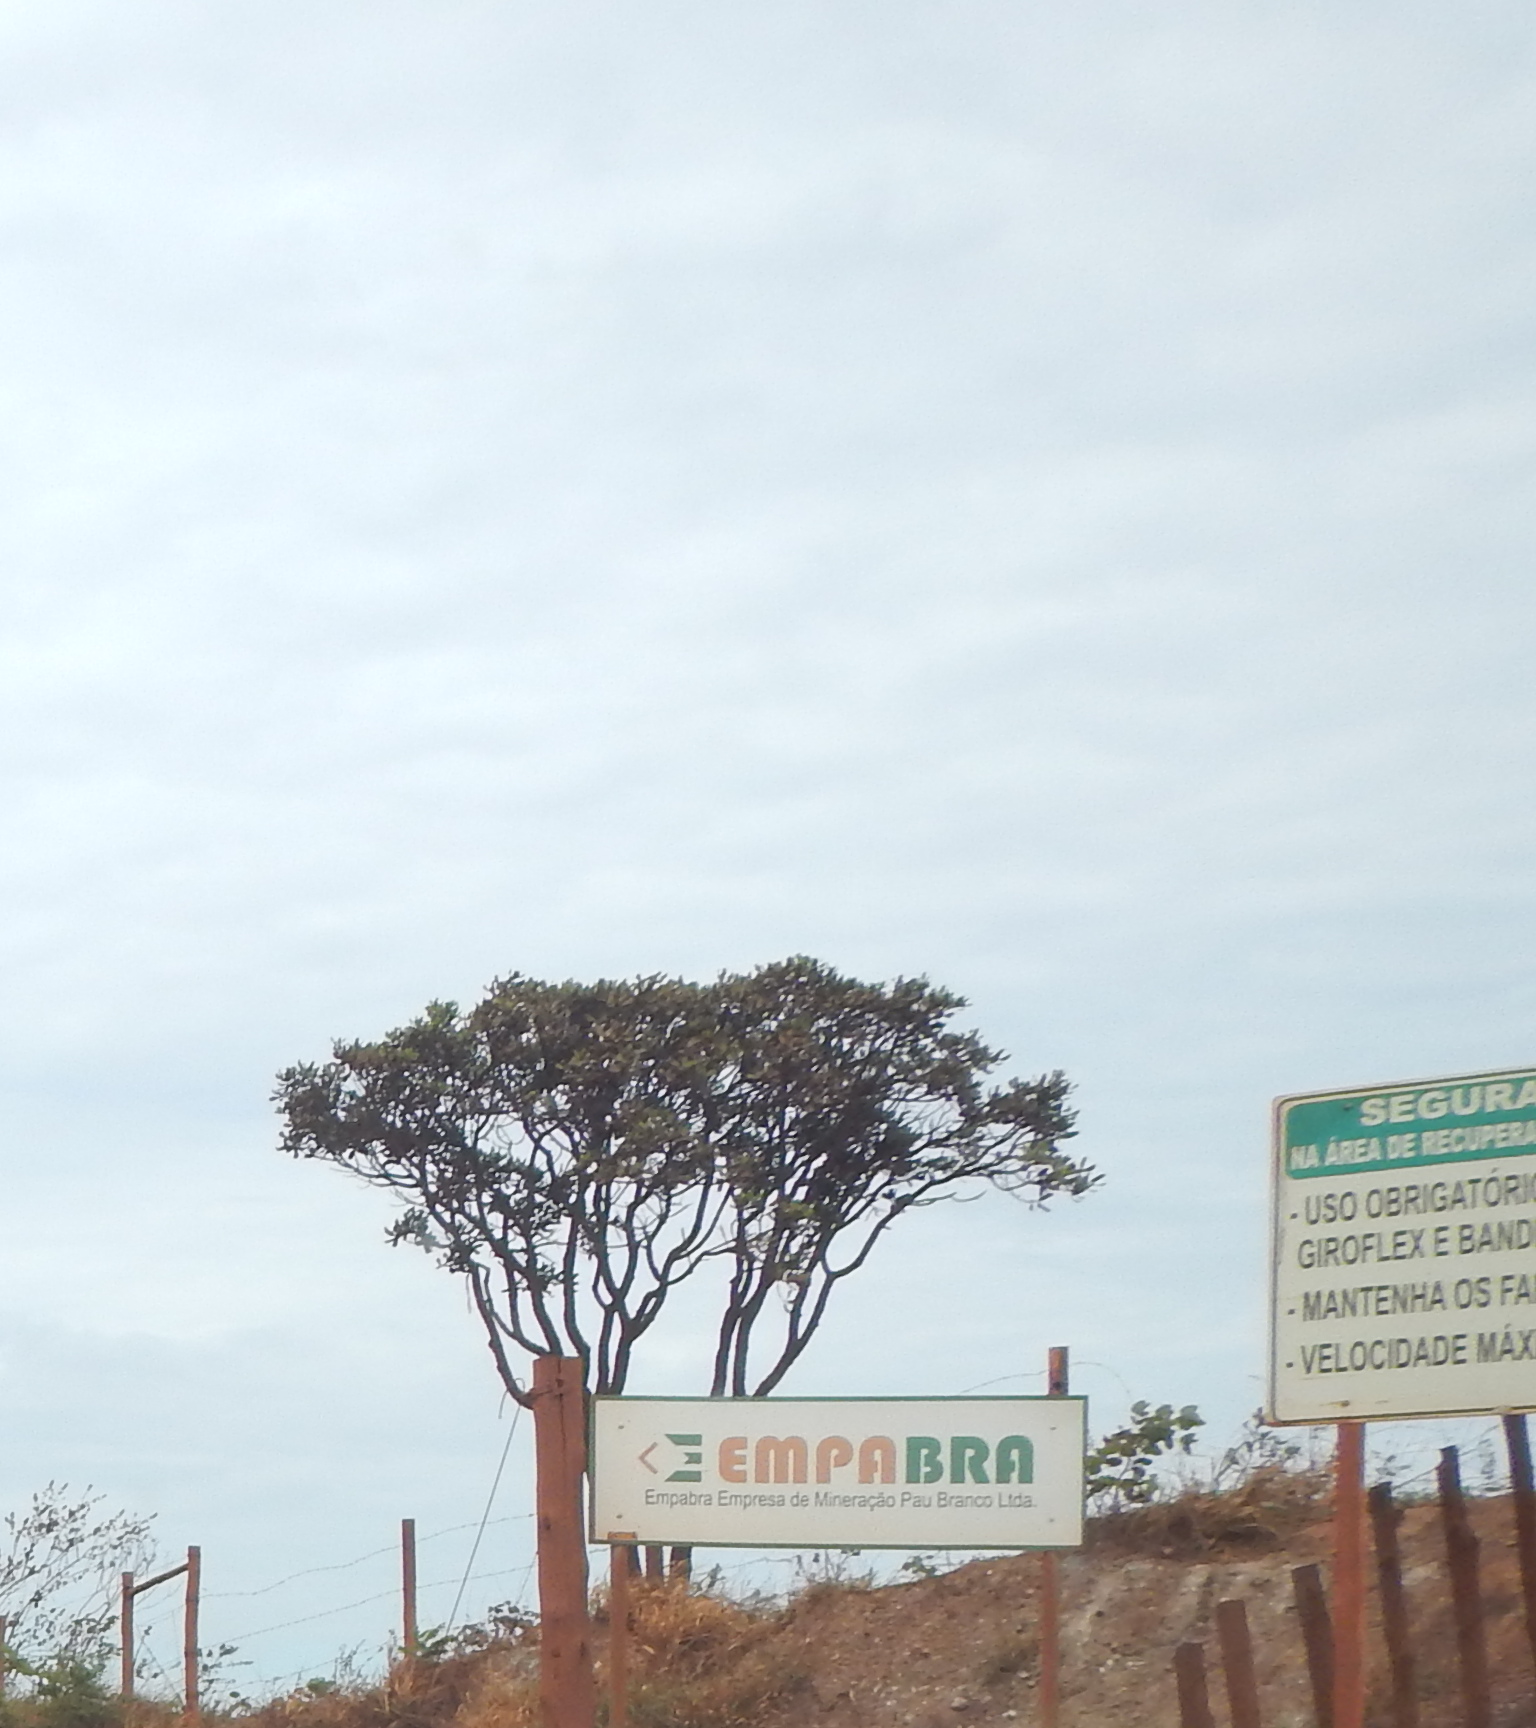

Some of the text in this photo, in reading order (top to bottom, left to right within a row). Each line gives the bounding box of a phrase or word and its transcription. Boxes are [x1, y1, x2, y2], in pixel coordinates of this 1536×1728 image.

[1290, 1144, 1320, 1170] NA
[1325, 1136, 1381, 1166] ÁREA
[1387, 1133, 1416, 1159] DE
[1305, 1193, 1357, 1225] USO
[1298, 1228, 1426, 1269] GIROFLEX
[1435, 1226, 1449, 1256] E
[1303, 1273, 1536, 1322] MANTENHA OS FA
[1301, 1334, 1467, 1374] VELOCIDADE
[717, 1435, 1033, 1484] EMPABRA
[645, 1489, 1037, 1511] Empabra Empresa de Mineração Pau Branco Ltda.
